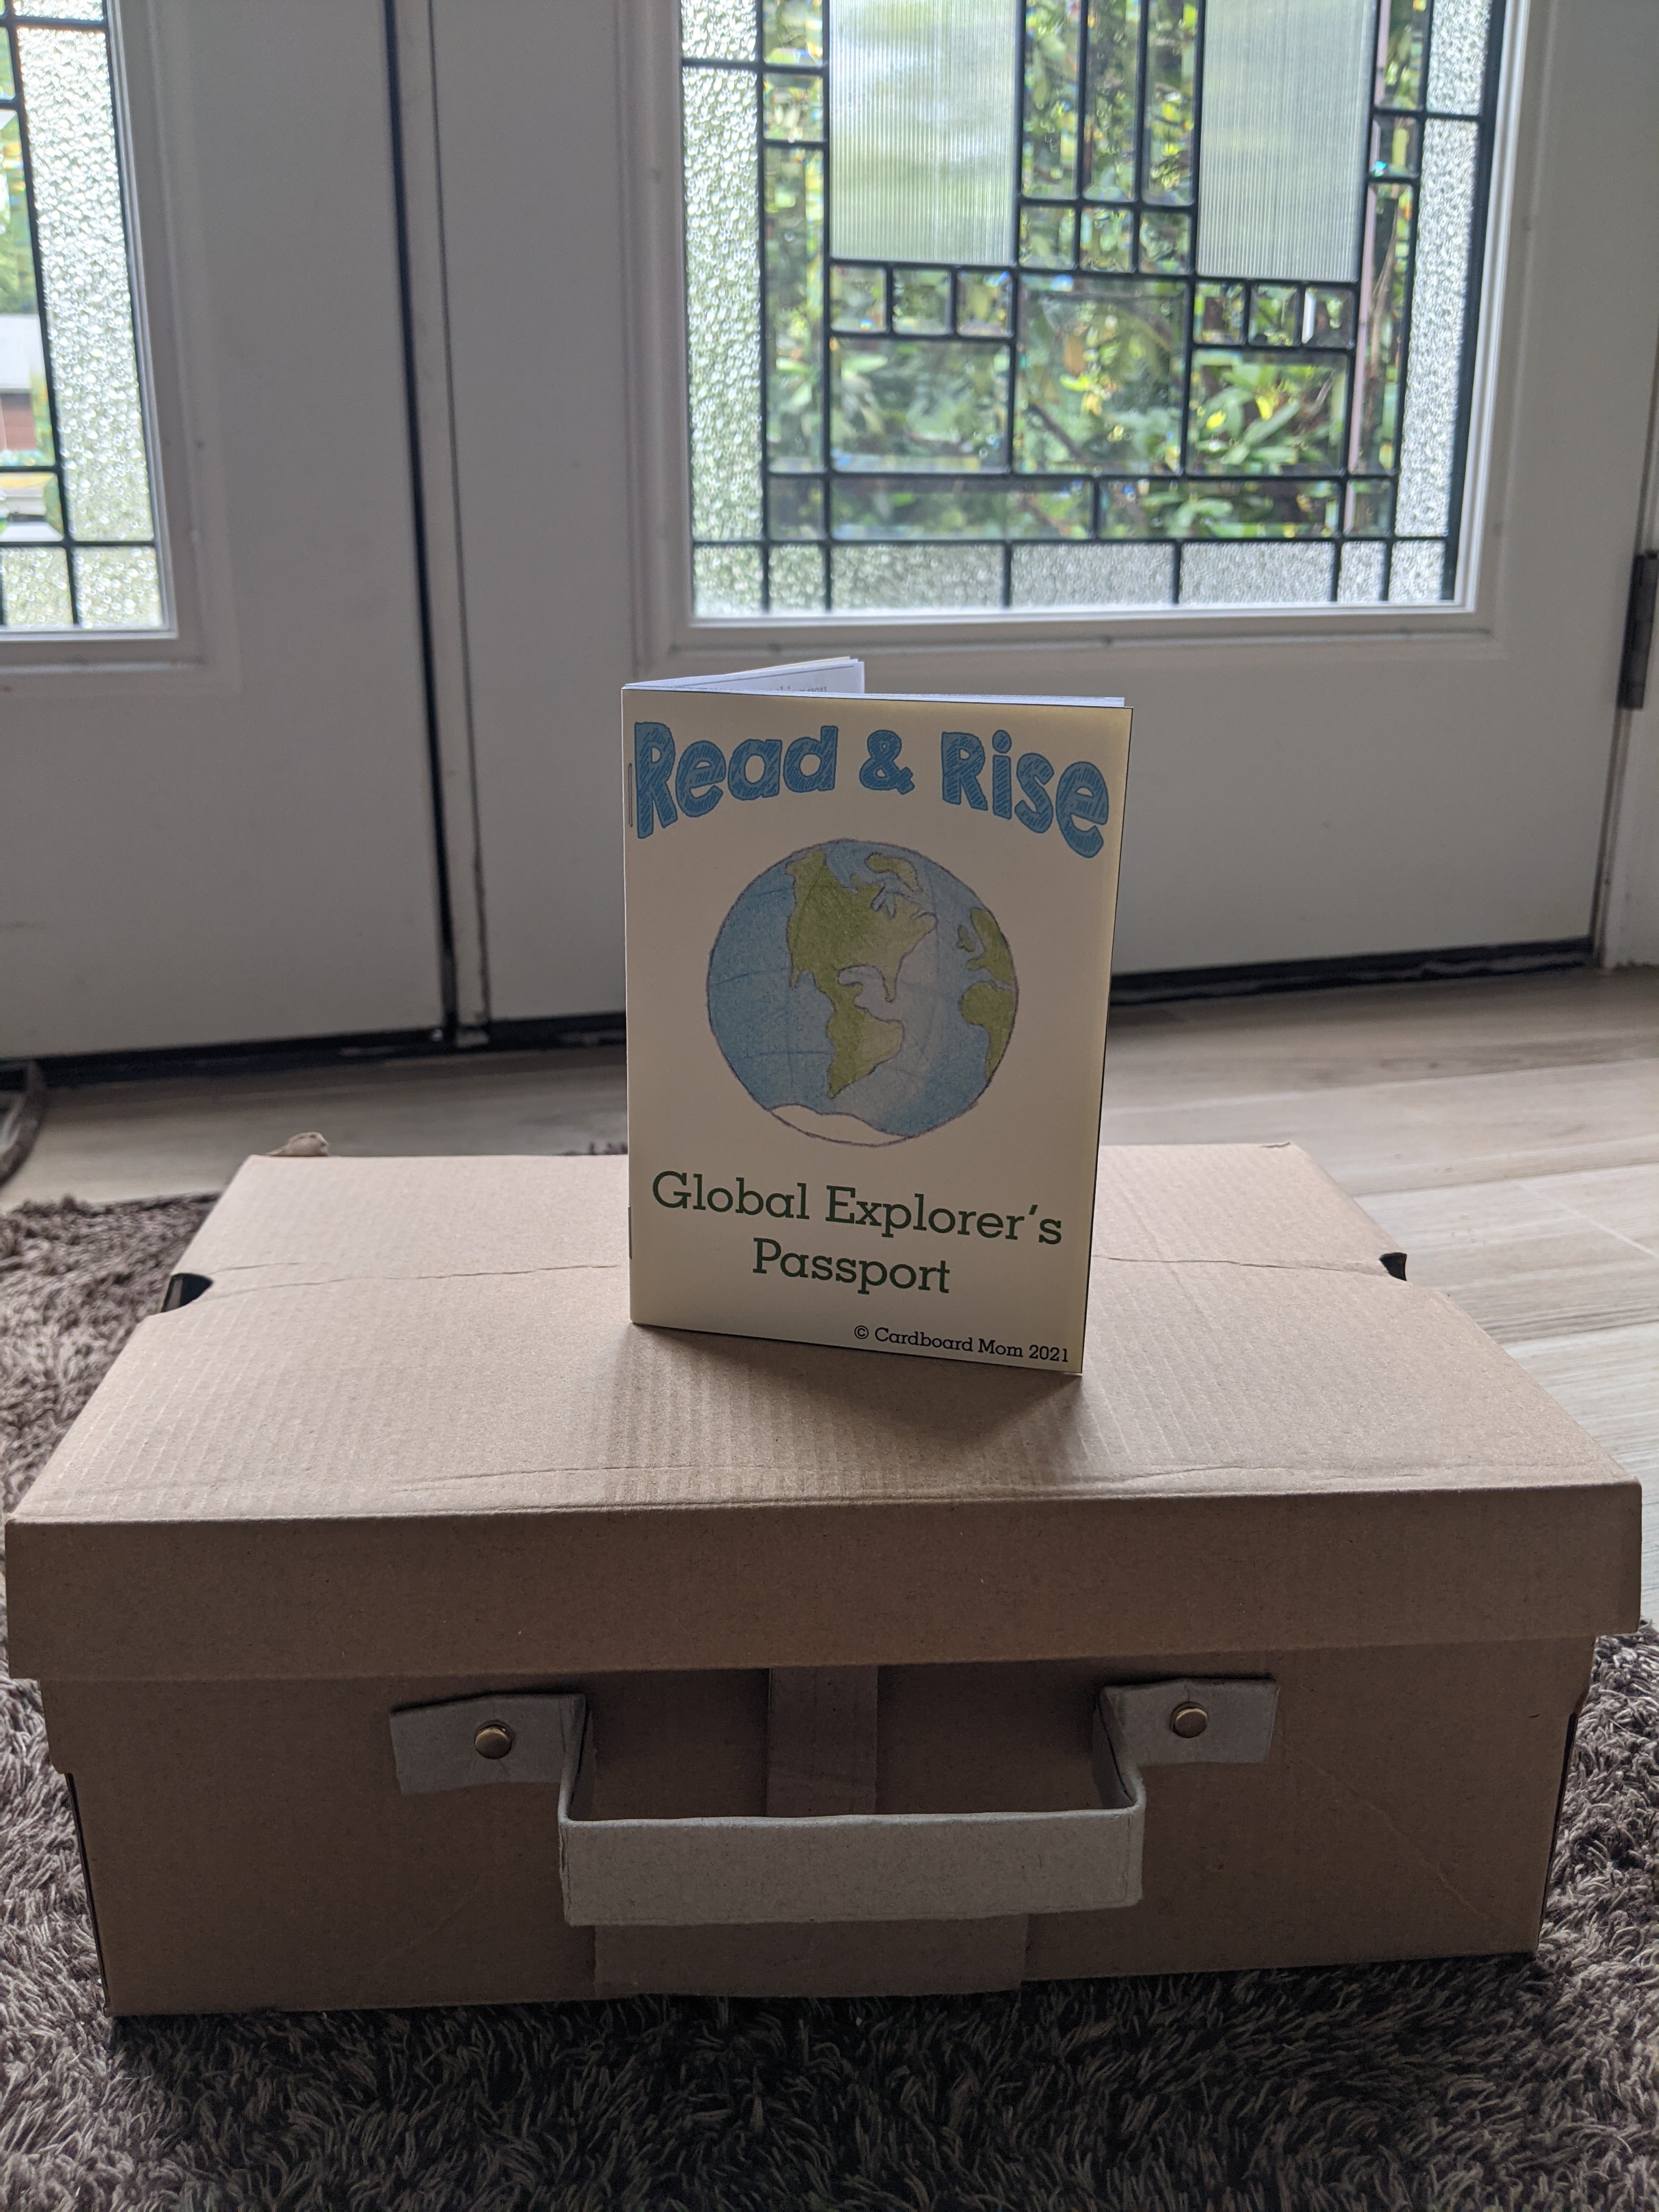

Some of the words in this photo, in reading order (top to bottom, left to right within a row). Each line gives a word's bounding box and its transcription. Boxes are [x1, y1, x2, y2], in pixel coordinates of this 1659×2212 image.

[634, 722, 838, 838] Read
[859, 730, 915, 794] &
[941, 730, 1109, 858] Rise
[652, 1171, 809, 1220] Global
[826, 1185, 1062, 1245] Explorer's
[752, 1238, 950, 1295] Passport
[874, 1327, 973, 1352] Cardboard
[978, 1339, 1023, 1358] Mom
[1029, 1345, 1069, 1362] 2021
